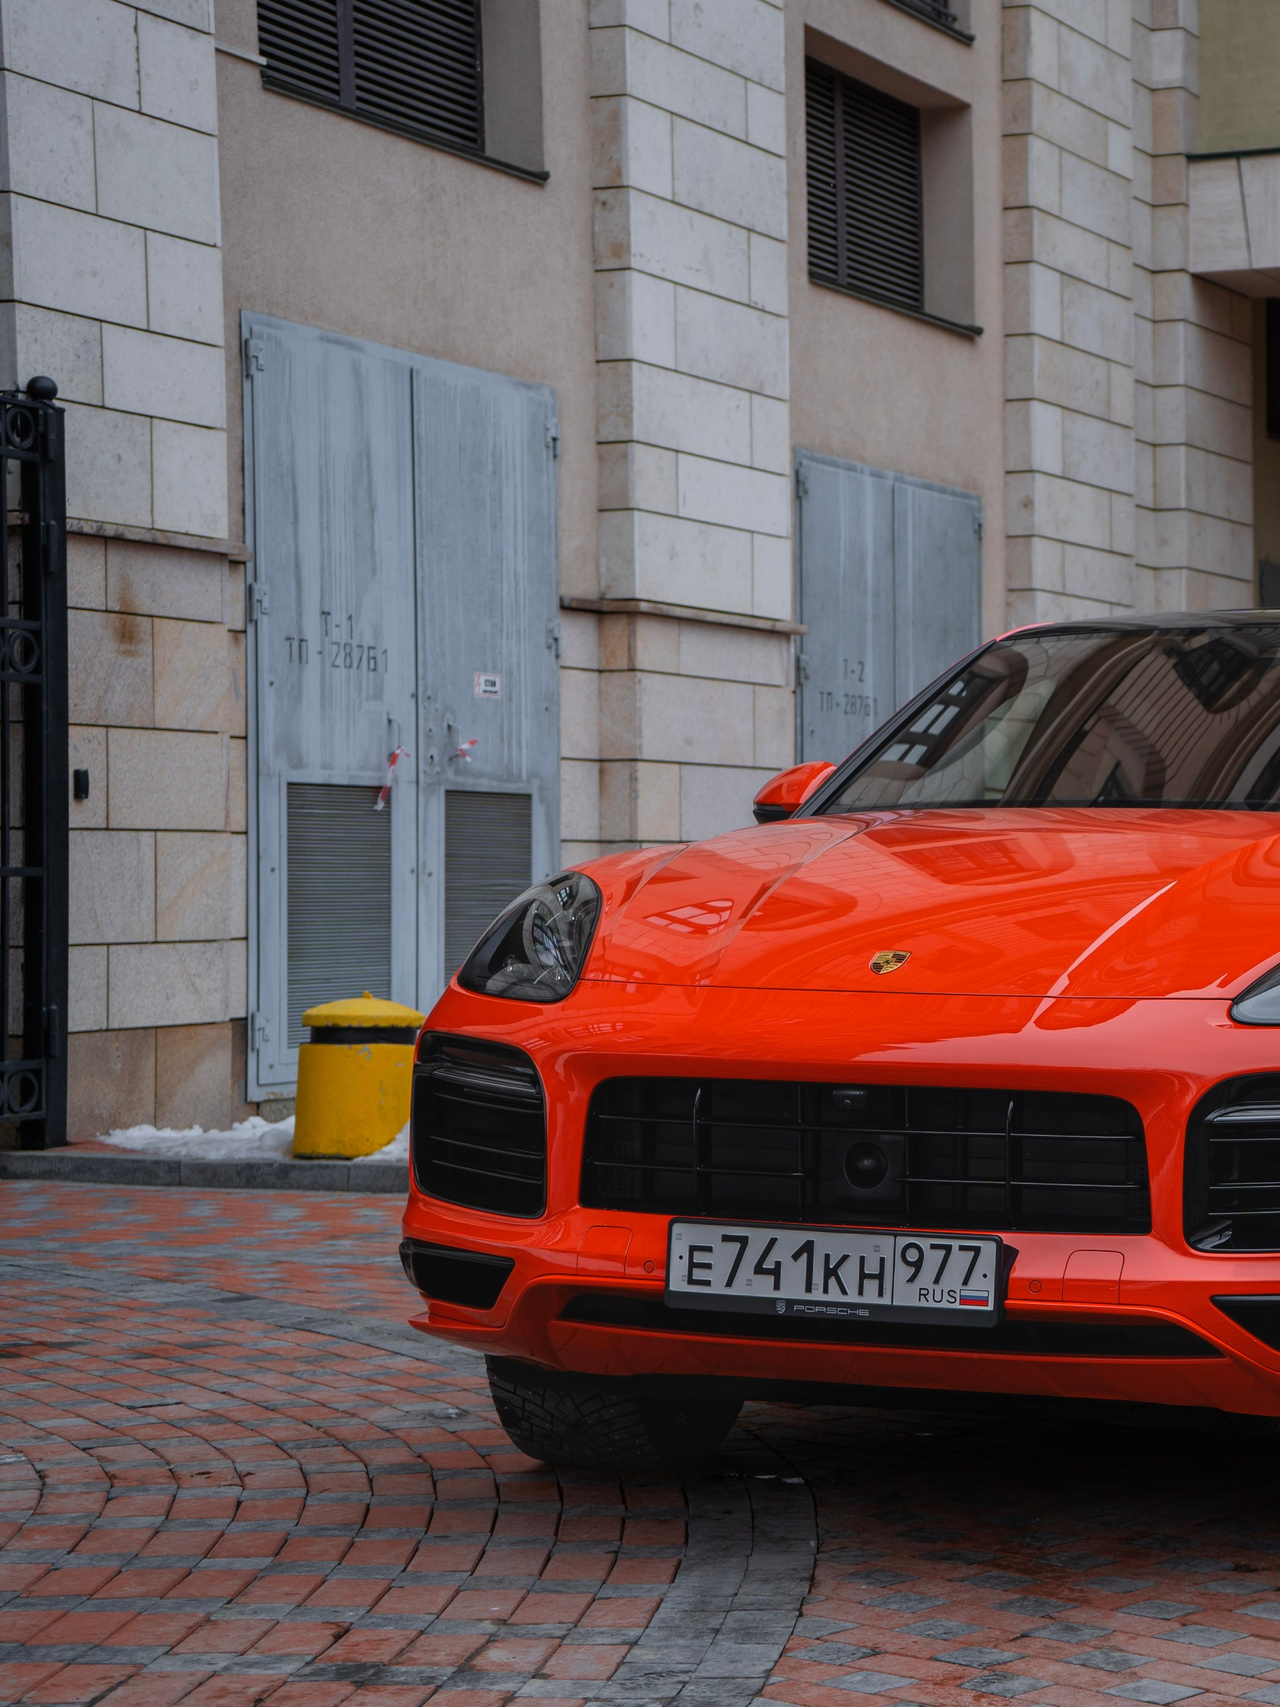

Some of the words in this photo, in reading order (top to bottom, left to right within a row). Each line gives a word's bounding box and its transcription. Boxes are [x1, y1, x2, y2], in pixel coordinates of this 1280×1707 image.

[900, 1241, 982, 1286] 977
[918, 1287, 957, 1304] RUS
[793, 1305, 870, 1317] PORSCHE
